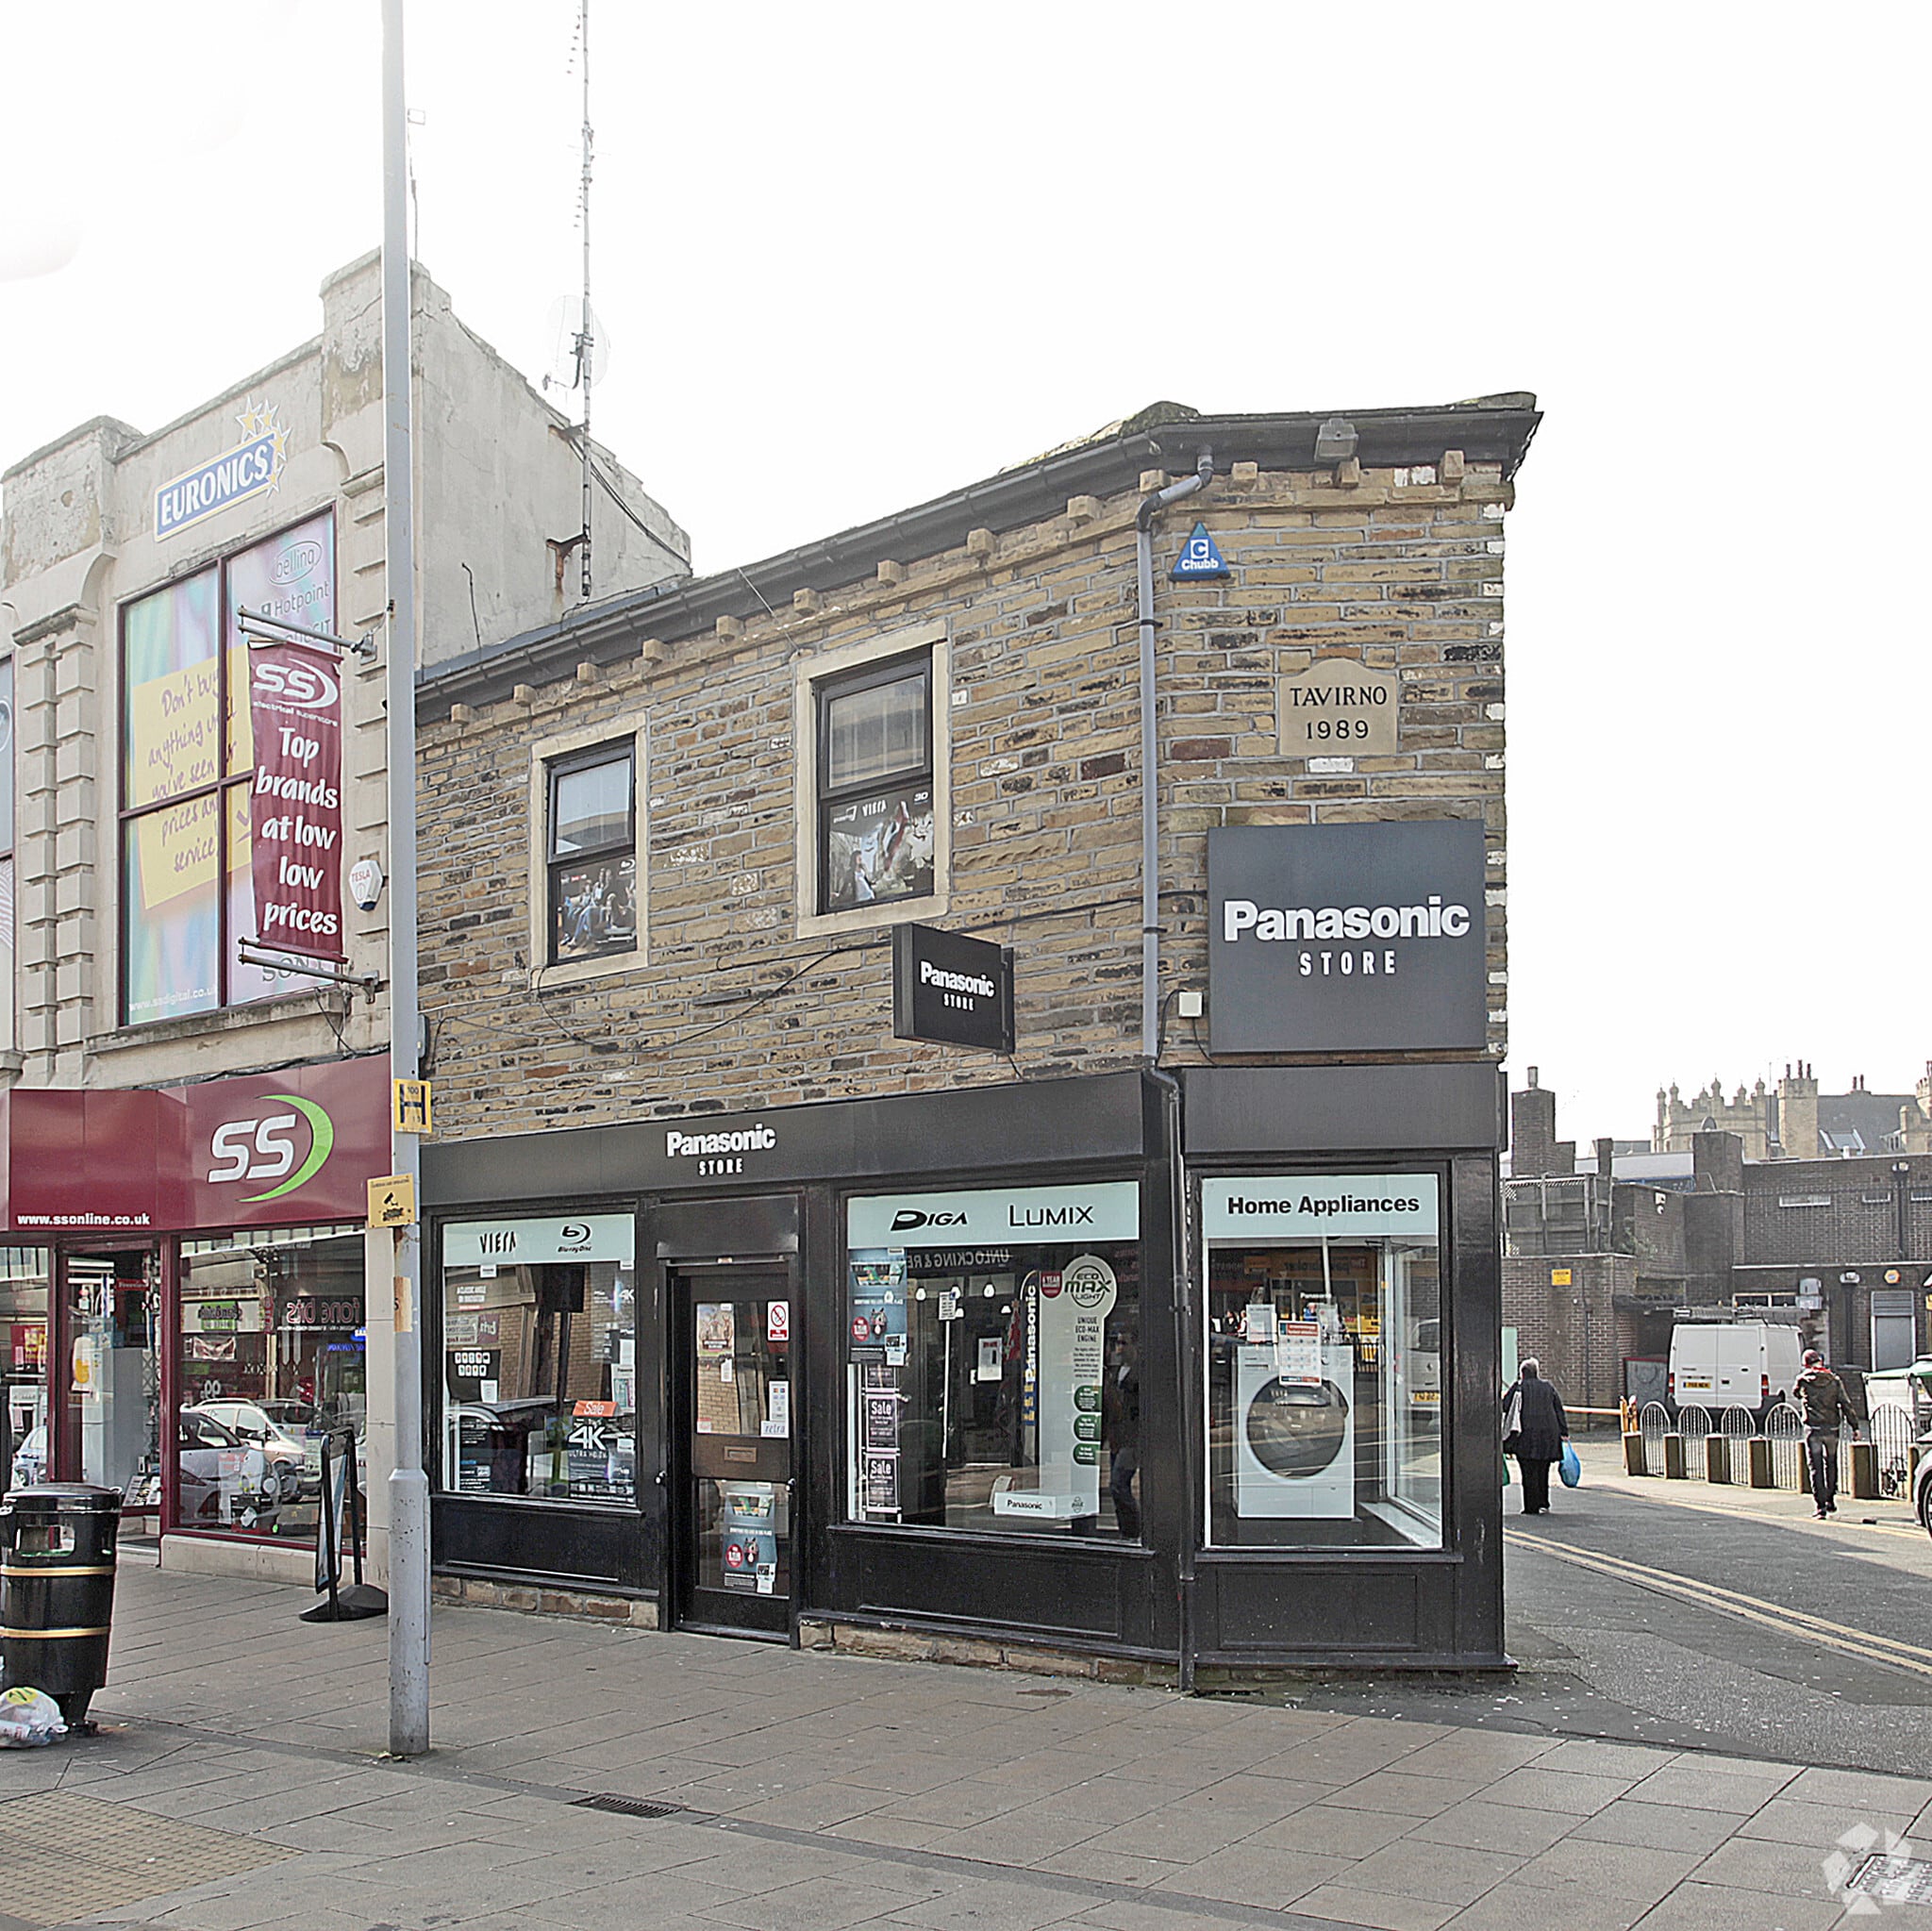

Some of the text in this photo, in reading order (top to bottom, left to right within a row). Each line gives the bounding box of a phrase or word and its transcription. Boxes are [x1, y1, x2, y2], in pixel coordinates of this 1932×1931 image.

[161, 444, 268, 526] EURONICS
[1181, 558, 1219, 571] Chubb
[275, 581, 329, 617] Hotpoint
[253, 663, 316, 700] SS
[1290, 686, 1388, 707] TAVIRNO
[1306, 720, 1370, 740] 1989
[278, 727, 320, 768] Top
[256, 765, 338, 809] brands
[261, 815, 337, 850] at low
[279, 856, 324, 890] low
[263, 902, 338, 935] prices
[1224, 895, 1471, 941] Panasonic
[1299, 950, 1396, 976] STORE
[921, 960, 995, 997] Panasonic
[943, 993, 974, 1011] STORE
[208, 1114, 297, 1184] SS
[666, 1123, 775, 1157] Panasonic
[699, 1157, 743, 1176] STORE
[1009, 1204, 1094, 1227] LUMIX
[1227, 1194, 1420, 1216] Home Appliances
[17, 1212, 151, 1225] www.ssonline.co.uk
[891, 1209, 969, 1232] DIGA
[1076, 1273, 1099, 1281] ECO
[1025, 1284, 1037, 1383] Panasonic
[583, 1403, 605, 1415] Sale
[871, 1401, 891, 1415] Sale
[568, 1425, 607, 1450] 4K
[871, 1459, 891, 1474] Sale
[1007, 1499, 1042, 1510] Panasonic
